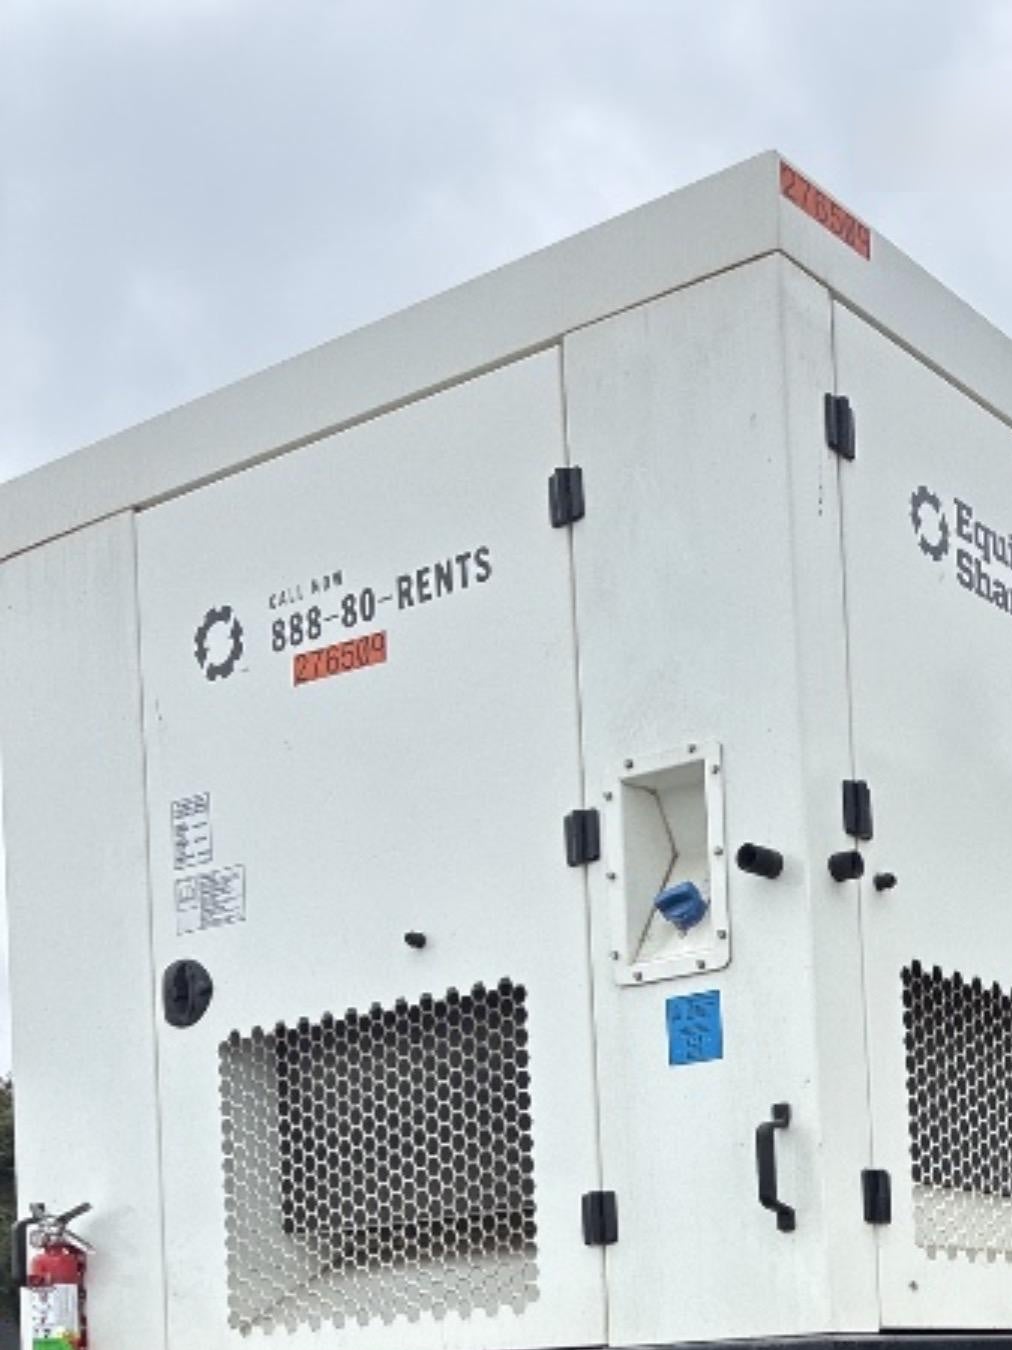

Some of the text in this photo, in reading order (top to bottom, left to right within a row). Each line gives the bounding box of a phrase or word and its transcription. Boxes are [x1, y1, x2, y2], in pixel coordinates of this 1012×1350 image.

[268, 584, 303, 610] CALL
[271, 545, 493, 652] 888-80-RENTS
[294, 631, 387, 687] 276509
